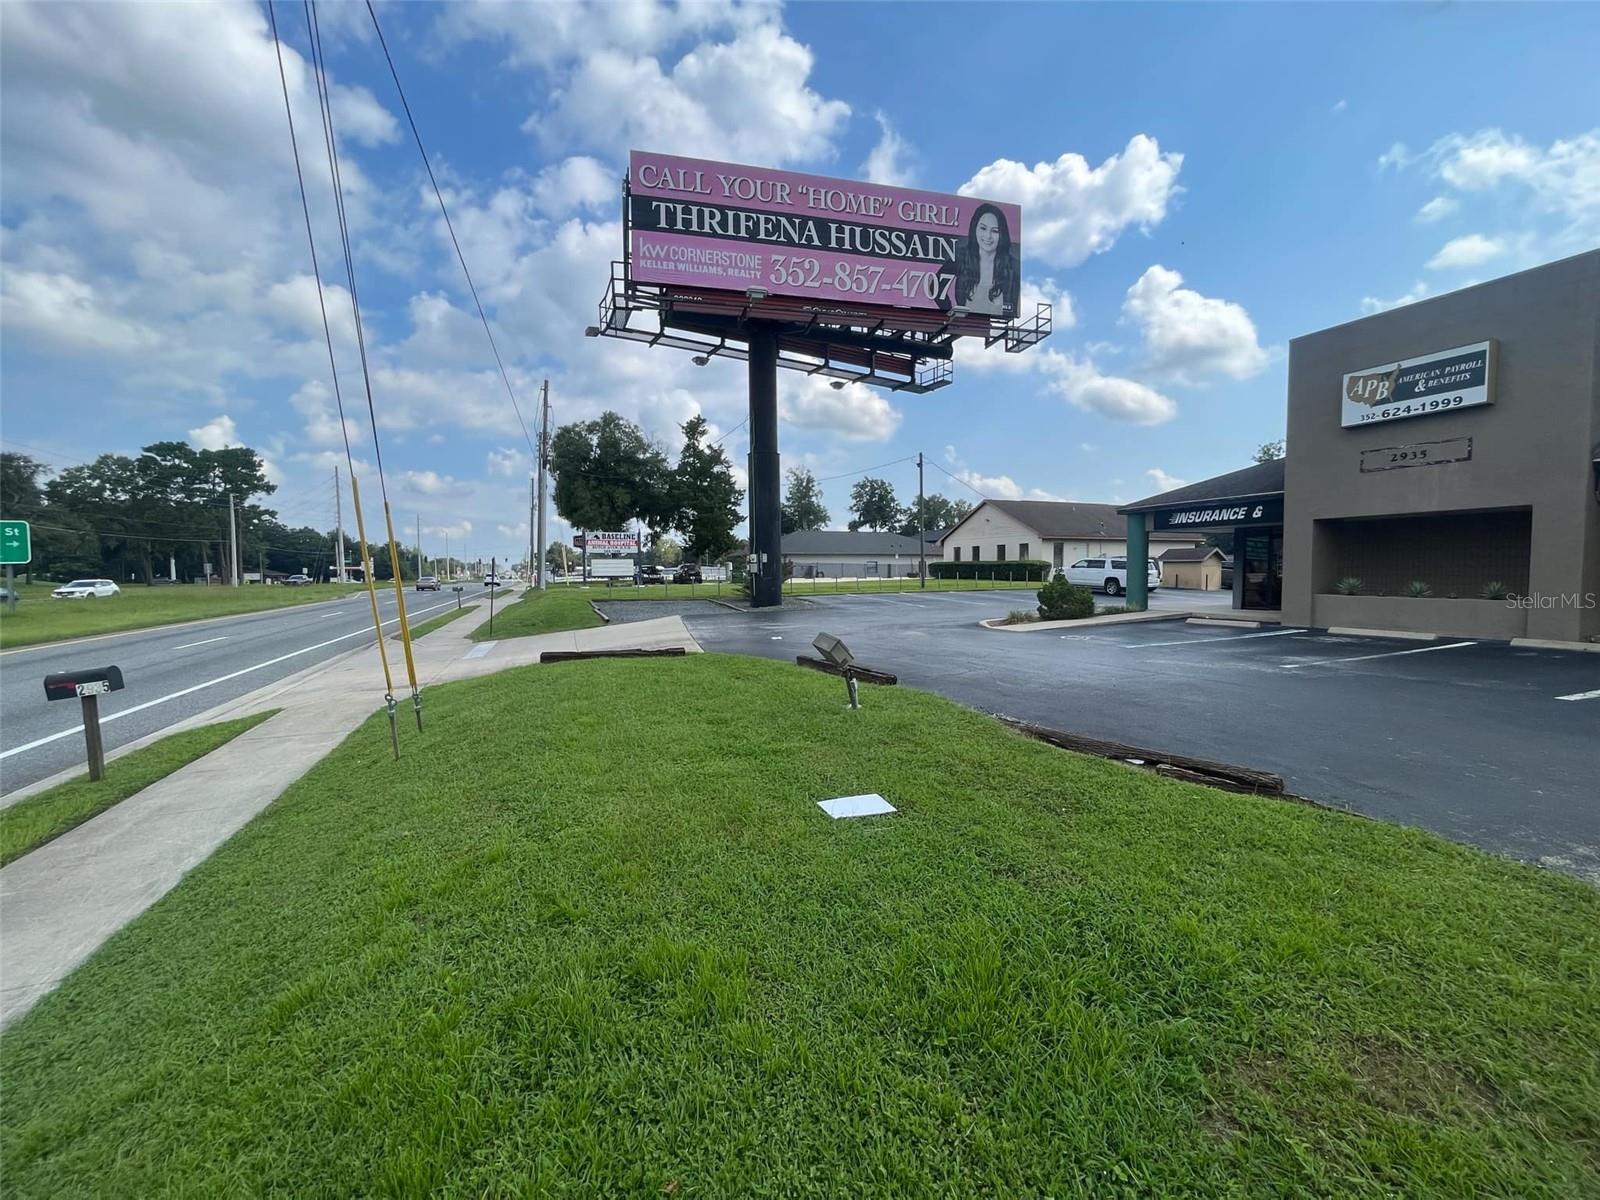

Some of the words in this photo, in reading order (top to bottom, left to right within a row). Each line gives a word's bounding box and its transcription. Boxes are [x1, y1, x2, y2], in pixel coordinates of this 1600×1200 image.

[638, 164, 712, 194] CALL
[716, 174, 793, 205] YOUR
[797, 184, 893, 217] "HOME"
[897, 200, 960, 227] GIRL!
[652, 201, 822, 247] THRIFENA
[828, 222, 958, 262] HUSSAIN
[639, 237, 668, 258] kw
[669, 245, 762, 269] CORNERSTONE
[639, 259, 675, 271] KELLER
[728, 267, 762, 279] REALTY
[769, 254, 956, 301] 352-857-4707
[1398, 368, 1442, 384] AMERICAN
[1445, 359, 1484, 374] PAYROLL
[1414, 379, 1427, 393] &
[1428, 372, 1471, 388] BENEFITS
[1350, 377, 1390, 401] APB
[1390, 449, 1428, 463] 2935
[1173, 507, 1248, 524] INSURANCE
[1252, 505, 1263, 518] &
[4, 527, 20, 536] St
